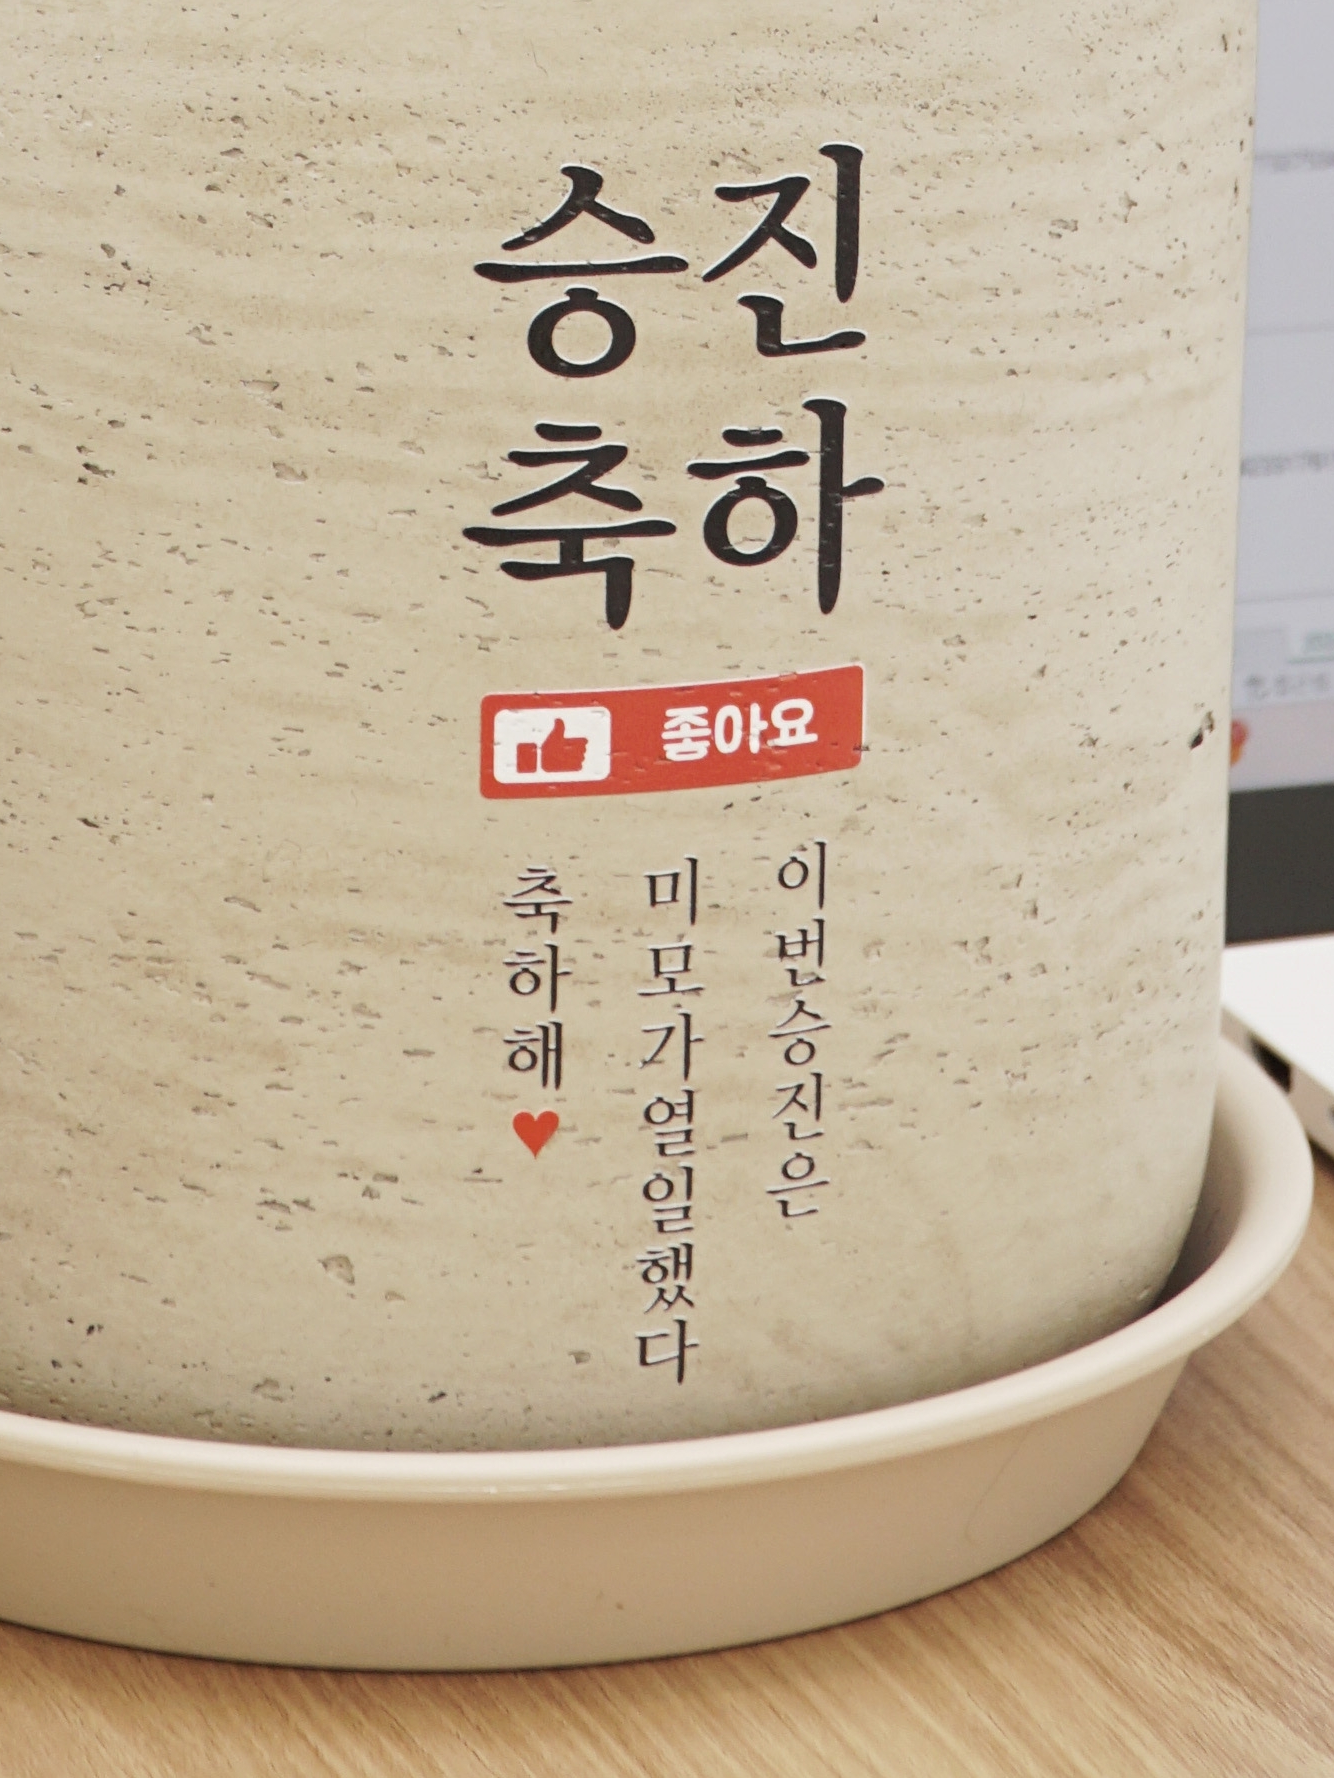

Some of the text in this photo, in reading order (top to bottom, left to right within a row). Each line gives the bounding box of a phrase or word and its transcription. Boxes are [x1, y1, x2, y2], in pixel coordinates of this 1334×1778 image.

[473, 142, 867, 378] 승진
[461, 397, 886, 631] 축하
[660, 697, 818, 761] 좋아요
